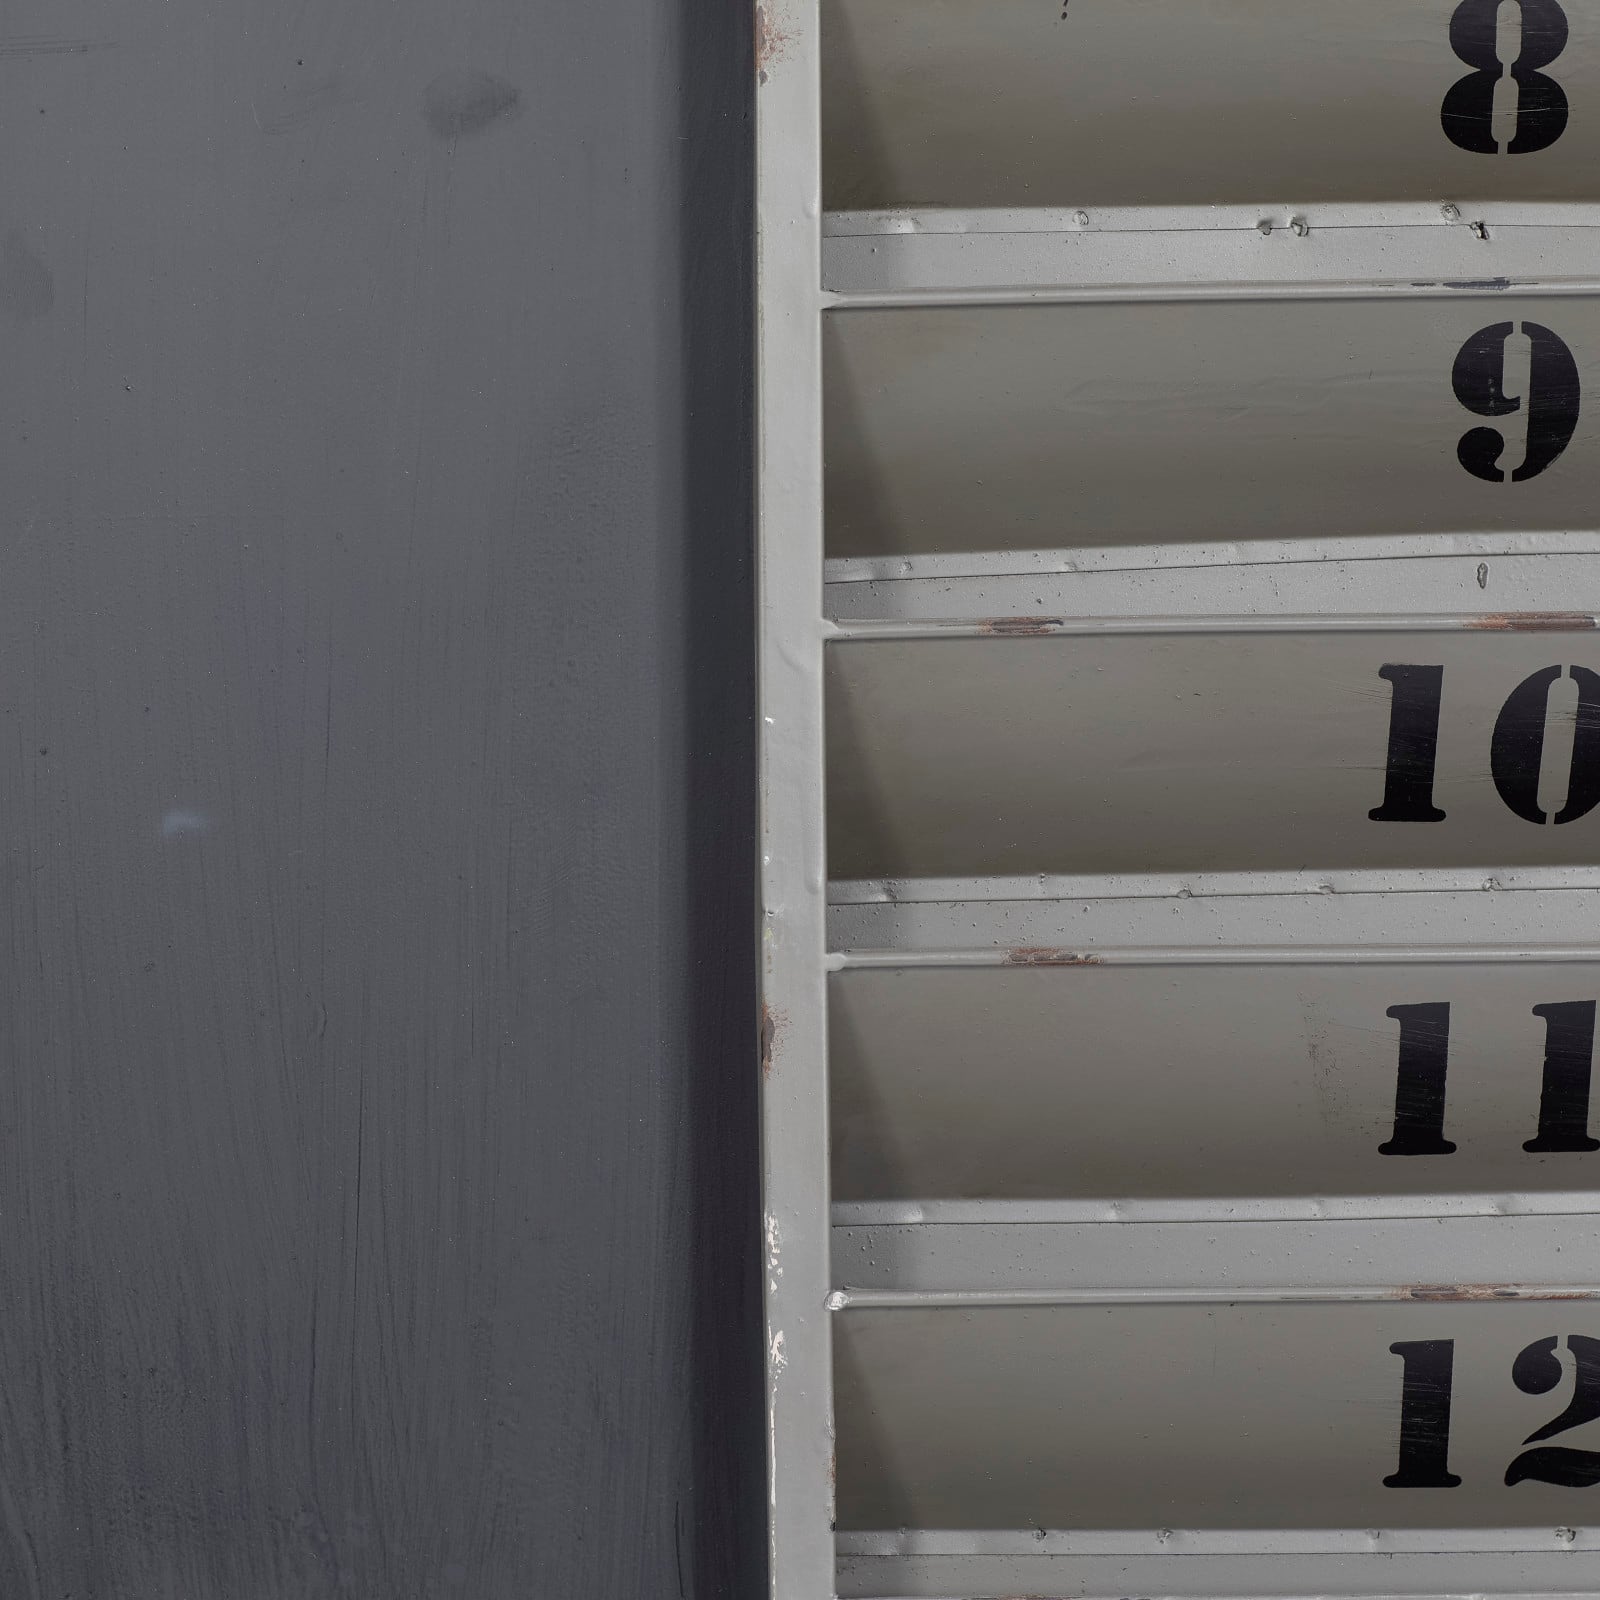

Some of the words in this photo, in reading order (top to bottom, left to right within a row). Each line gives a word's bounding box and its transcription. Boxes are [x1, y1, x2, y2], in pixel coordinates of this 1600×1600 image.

[1440, 0, 1569, 155] 8
[1452, 321, 1581, 483] 9
[1367, 663, 1600, 826] 10
[1377, 999, 1600, 1157] 11
[1381, 1334, 1600, 1489] 12
